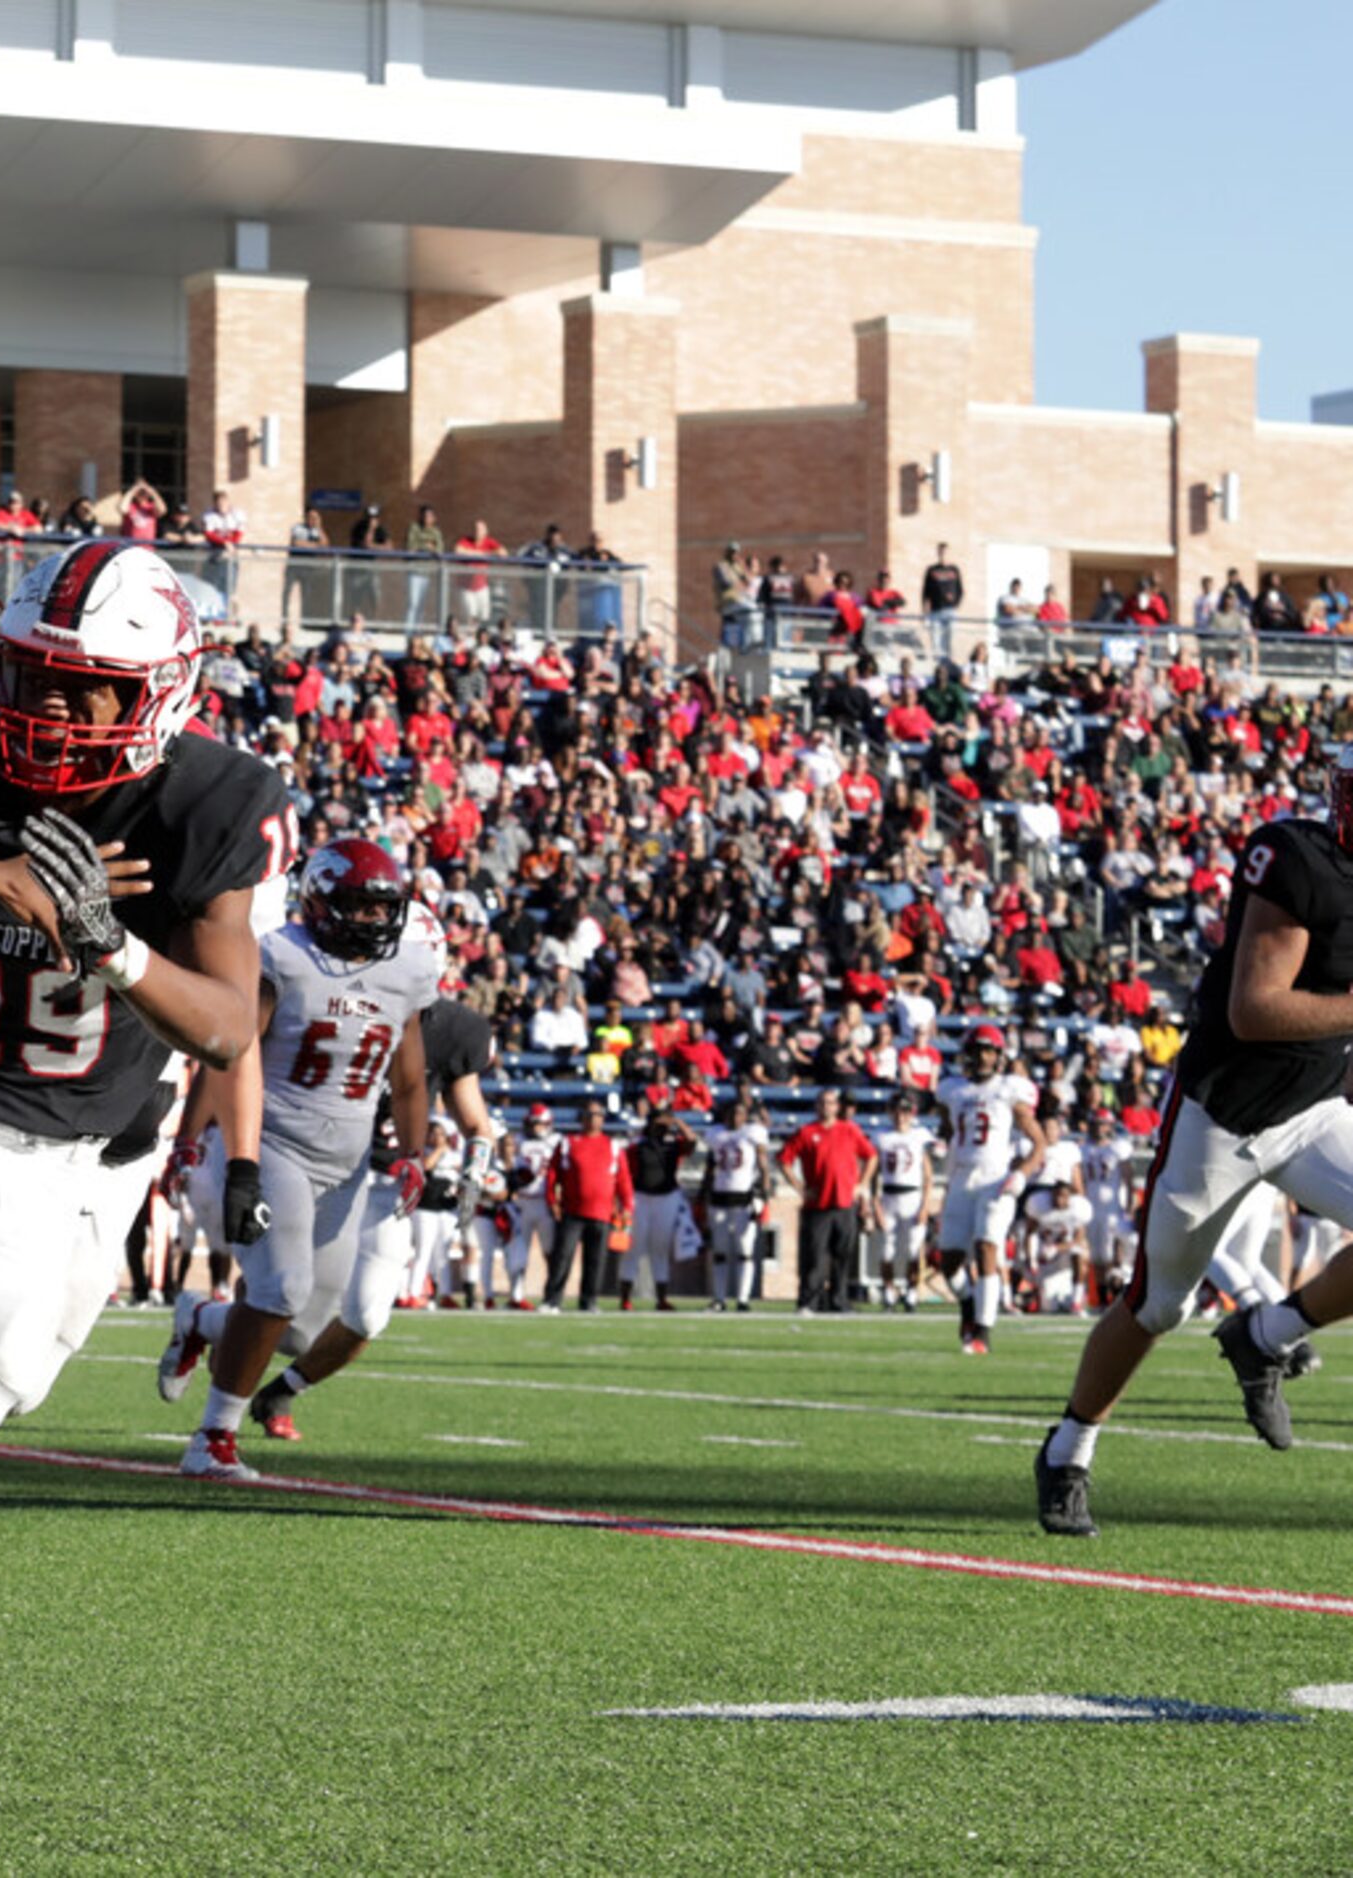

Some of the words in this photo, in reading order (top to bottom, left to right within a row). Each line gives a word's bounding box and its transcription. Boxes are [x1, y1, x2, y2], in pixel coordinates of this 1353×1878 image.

[1244, 844, 1275, 886] 9
[288, 1019, 393, 1100] 60
[956, 1111, 990, 1147] 13
